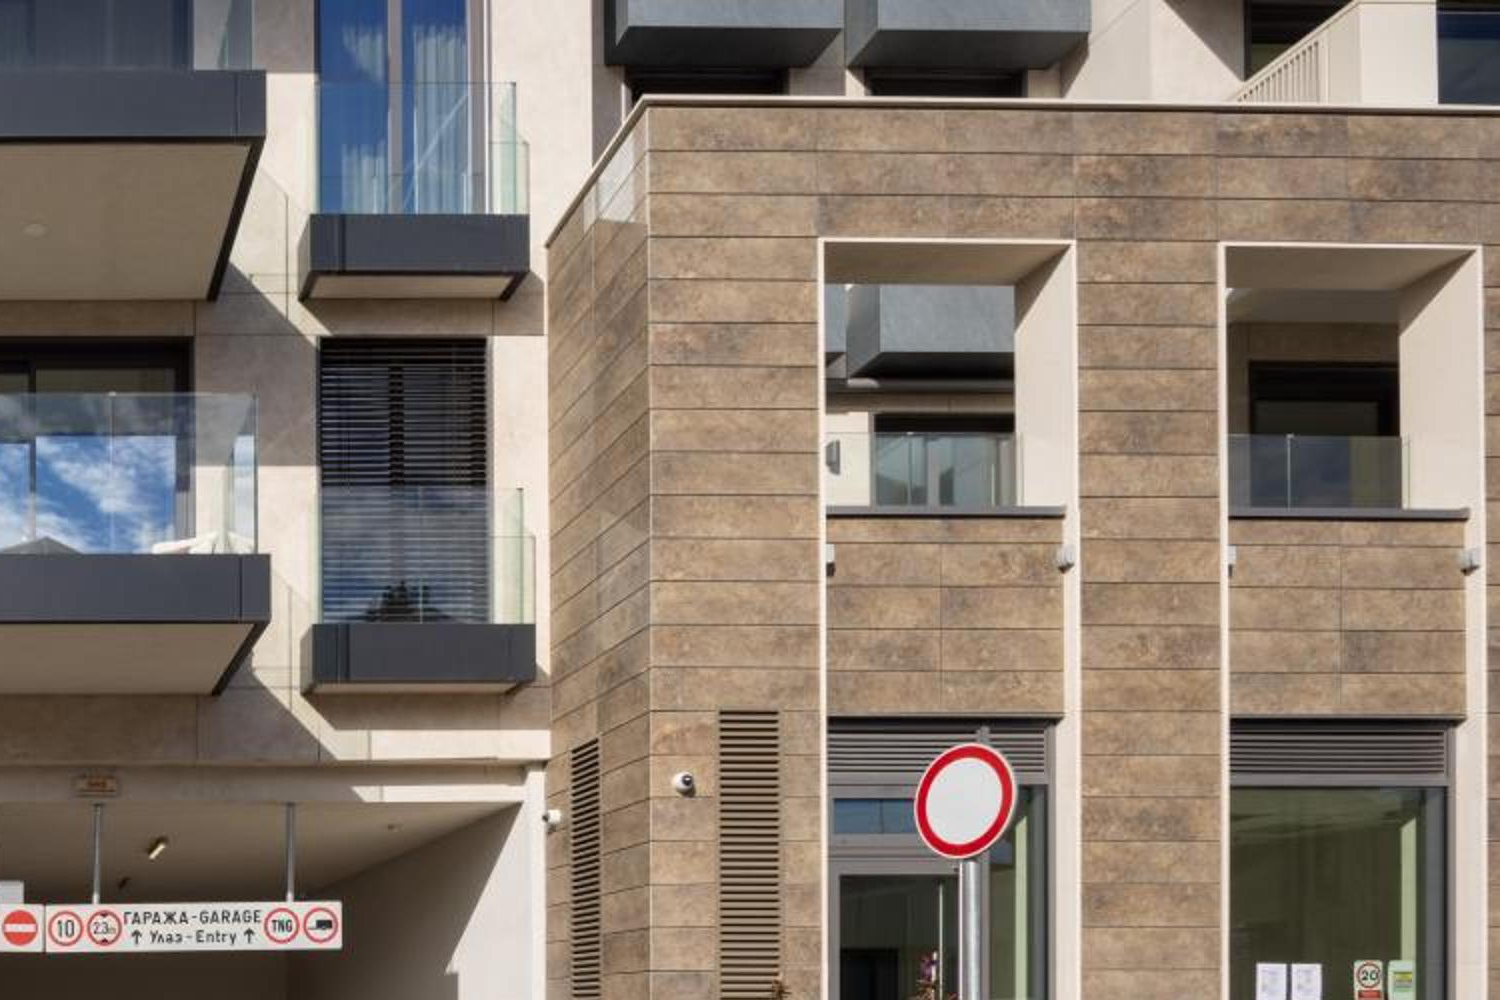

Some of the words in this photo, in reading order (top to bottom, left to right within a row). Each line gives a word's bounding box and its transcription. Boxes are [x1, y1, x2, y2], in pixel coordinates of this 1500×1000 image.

[57, 919, 75, 938] 10
[271, 919, 293, 933] TNG
[1361, 969, 1379, 981] 20
